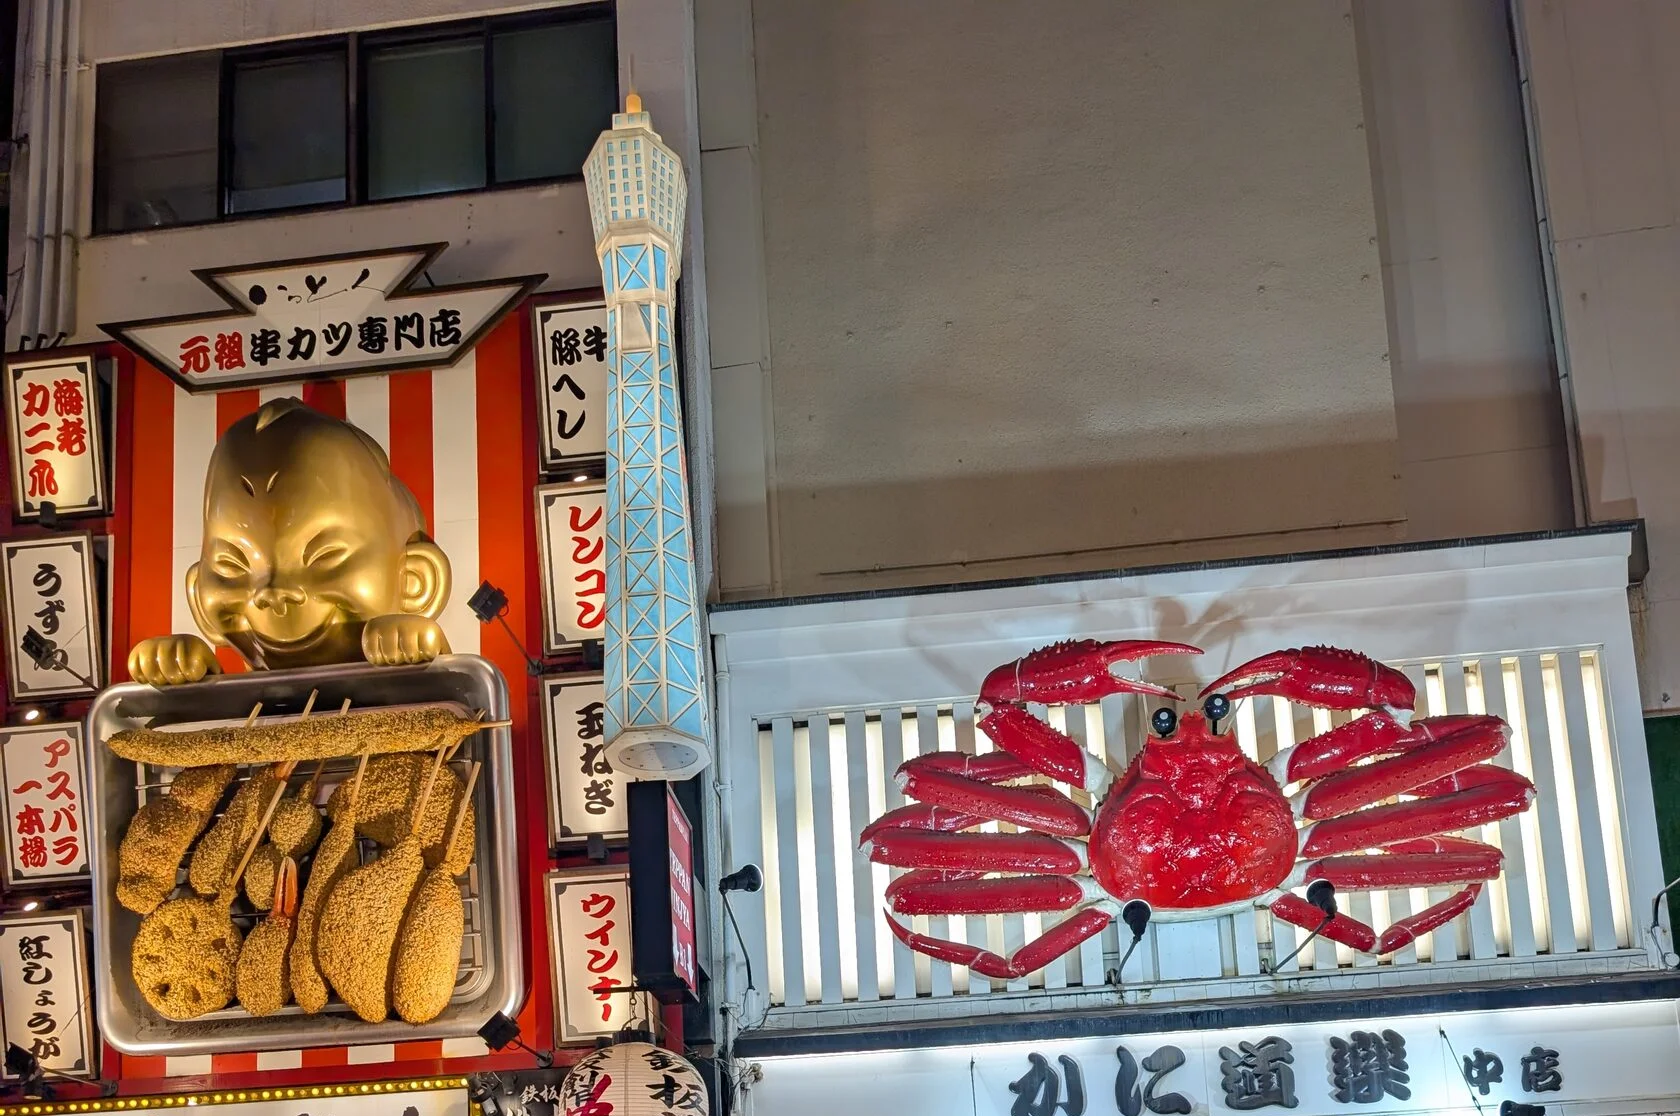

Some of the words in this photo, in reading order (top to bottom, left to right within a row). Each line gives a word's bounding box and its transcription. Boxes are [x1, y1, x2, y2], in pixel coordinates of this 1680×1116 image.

[53, 378, 87, 457] 海老
[568, 504, 607, 630] レンコン
[43, 738, 80, 867] アスパラ
[18, 935, 62, 1062] 紅しょうが
[1463, 1046, 1563, 1096] 中店
